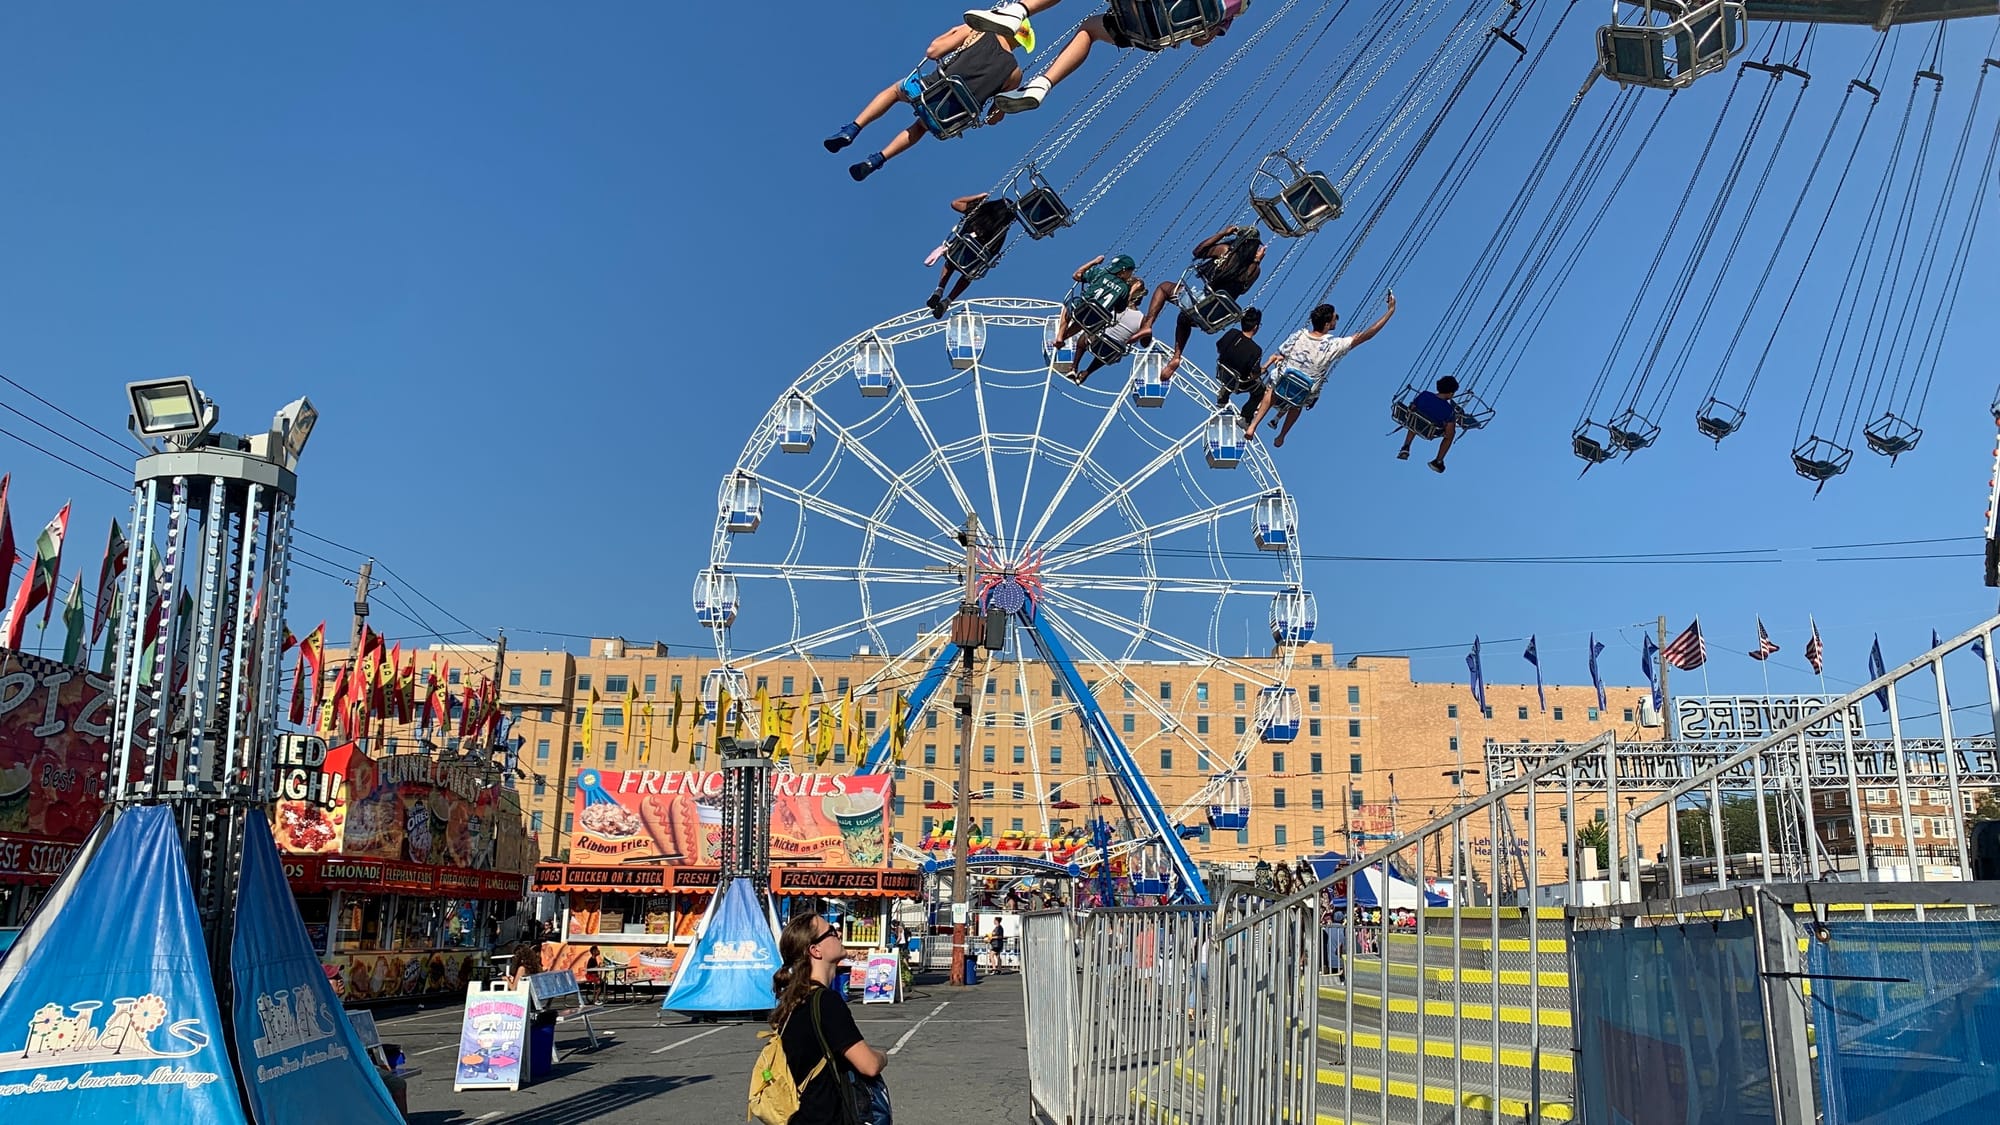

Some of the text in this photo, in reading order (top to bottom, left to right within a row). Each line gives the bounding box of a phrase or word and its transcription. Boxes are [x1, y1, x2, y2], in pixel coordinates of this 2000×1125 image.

[0, 671, 174, 760] PIZZ
[42, 764, 75, 792] Best
[378, 757, 433, 786] FUNNEL
[270, 768, 343, 808] UGH!
[618, 769, 850, 797] FRENC RIES
[577, 835, 650, 854] Ribbon Fries
[769, 836, 799, 852] Chicken
[801, 845, 811, 853] on
[320, 864, 382, 880] LEMONADE
[385, 868, 432, 884] ELEPHANT EARS
[440, 873, 457, 886] FRIED
[541, 870, 561, 881] DOGS
[569, 870, 662, 884] CHICKEN ON A STICK
[676, 872, 709, 885] FRESH
[485, 876, 520, 890] FUNNEL CAKES
[783, 874, 876, 887] FRENCH FRIES
[502, 1021, 522, 1031] THIS
[501, 1031, 519, 1041] WAY
[27, 1073, 69, 1094] Great
[69, 1070, 139, 1090] American
[143, 1066, 217, 1089] Midways
